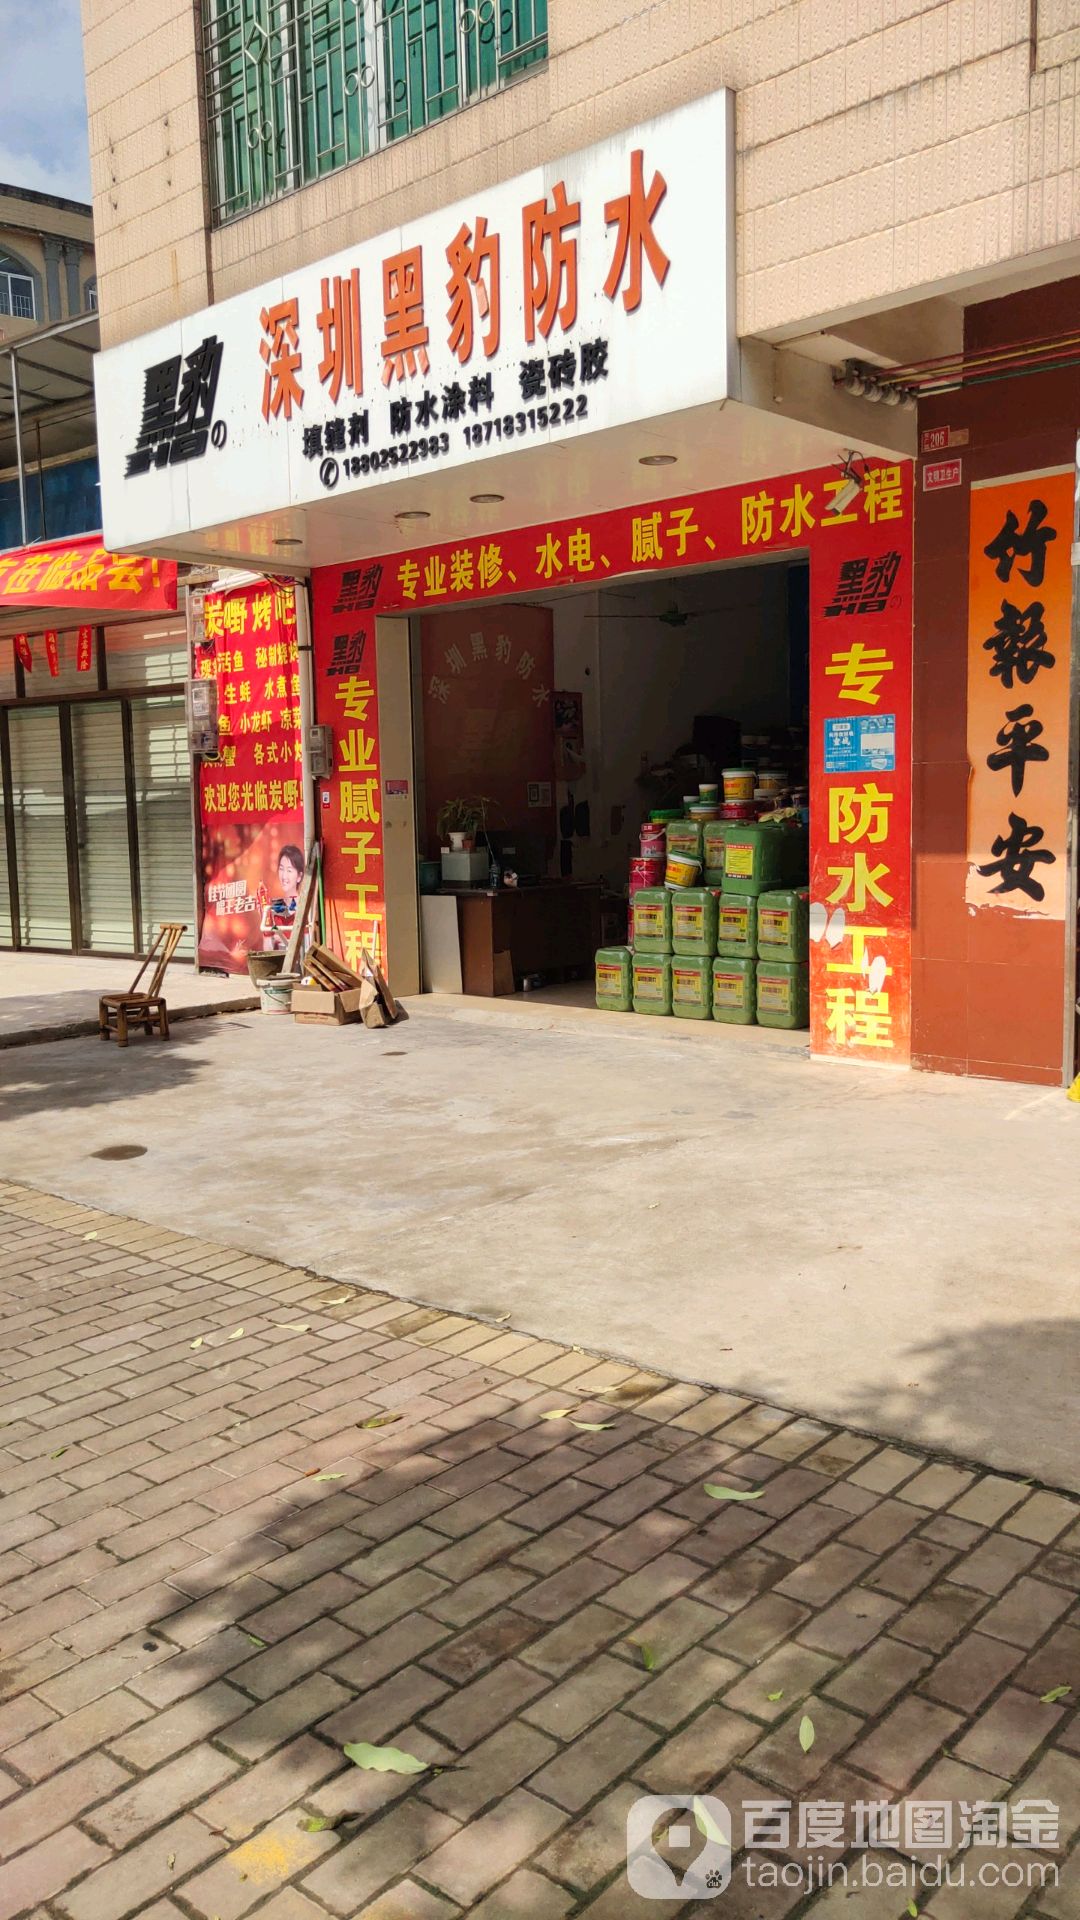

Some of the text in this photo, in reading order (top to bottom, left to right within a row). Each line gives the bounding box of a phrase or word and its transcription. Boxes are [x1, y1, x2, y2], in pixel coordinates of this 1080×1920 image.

[259, 149, 671, 423] 深圳黑豹防水
[390, 372, 494, 435] 防水涂料
[519, 338, 609, 401] 瓷砖胶
[343, 394, 588, 477] 18802522983 18718315222
[930, 431, 945, 448] 206
[217, 681, 251, 704] 生蚝
[428, 632, 550, 707] 深圳黑豹防水
[240, 711, 272, 734] 小龙虾
